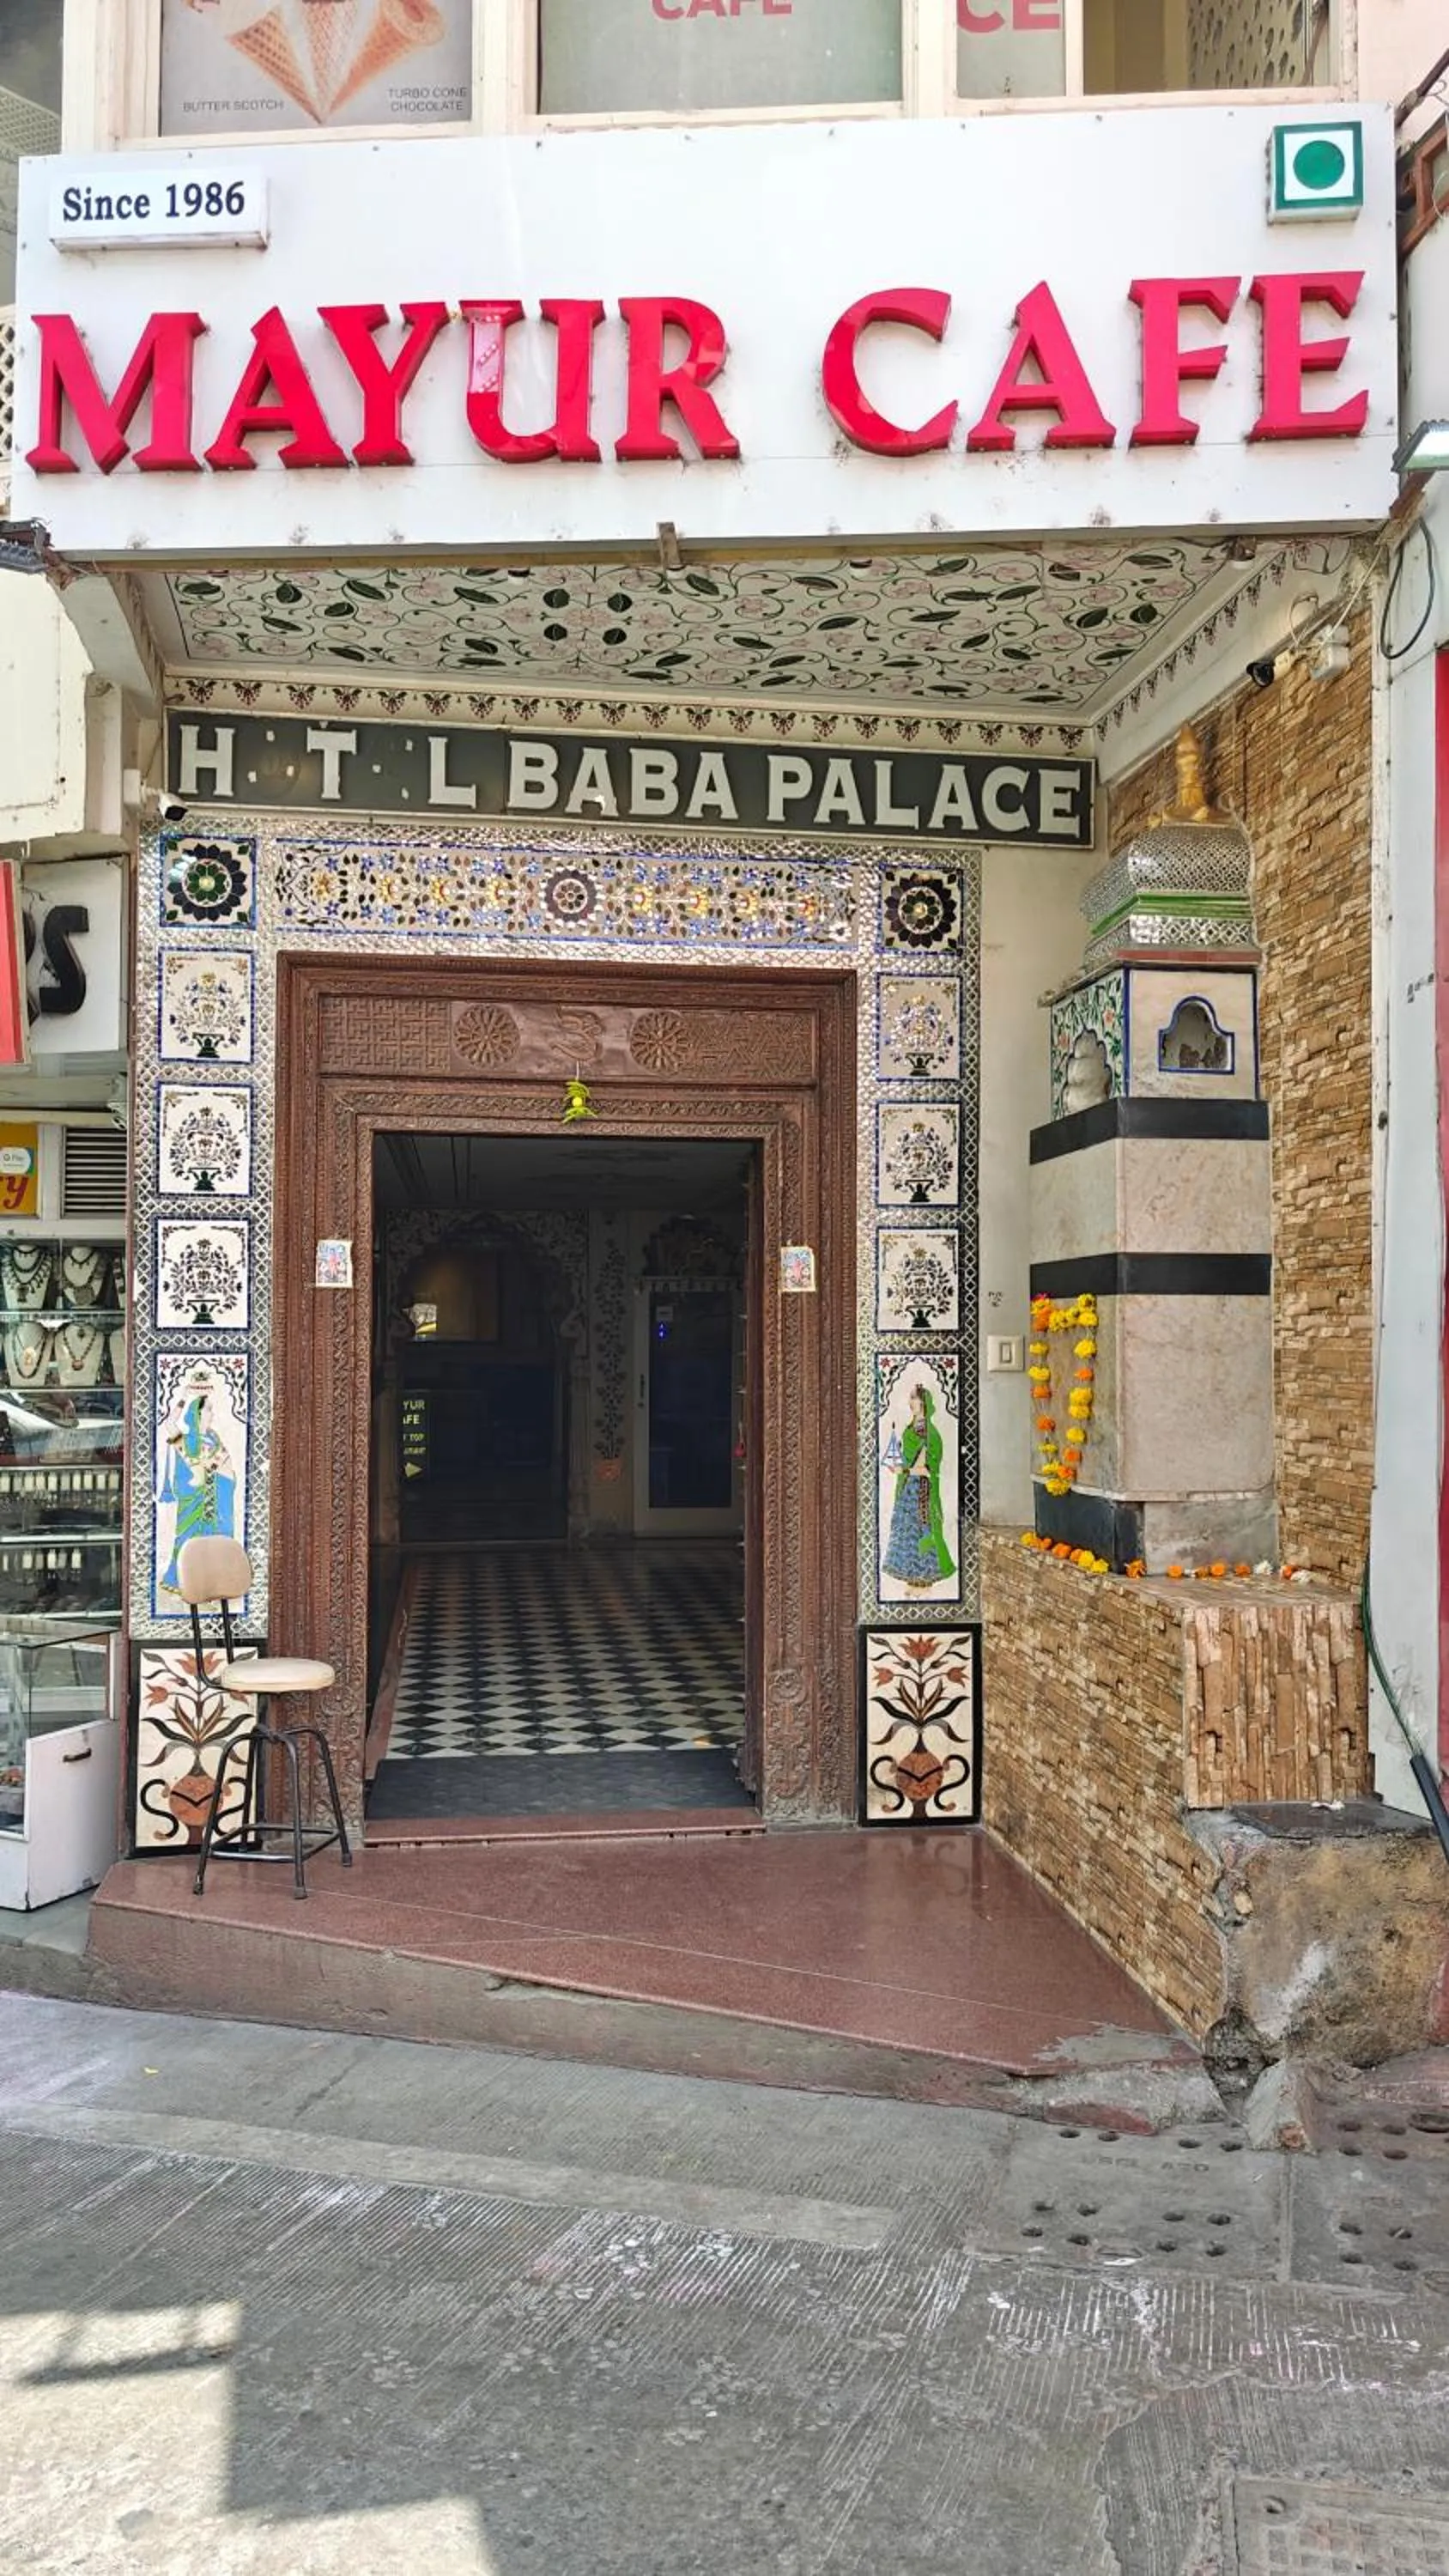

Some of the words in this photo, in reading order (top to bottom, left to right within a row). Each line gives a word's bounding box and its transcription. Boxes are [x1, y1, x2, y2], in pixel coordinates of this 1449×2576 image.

[183, 100, 230, 112] BUTTER
[233, 99, 284, 112] SCOTCH
[388, 87, 430, 99] TURBO
[432, 87, 468, 99] CONE
[391, 100, 464, 112] CHOCOLATE
[63, 186, 151, 222] Since
[165, 180, 246, 217] 1986
[24, 297, 741, 474] MAYUR
[822, 270, 1369, 458] CAFE
[507, 740, 739, 820] BABA
[767, 755, 1081, 839] PALACE
